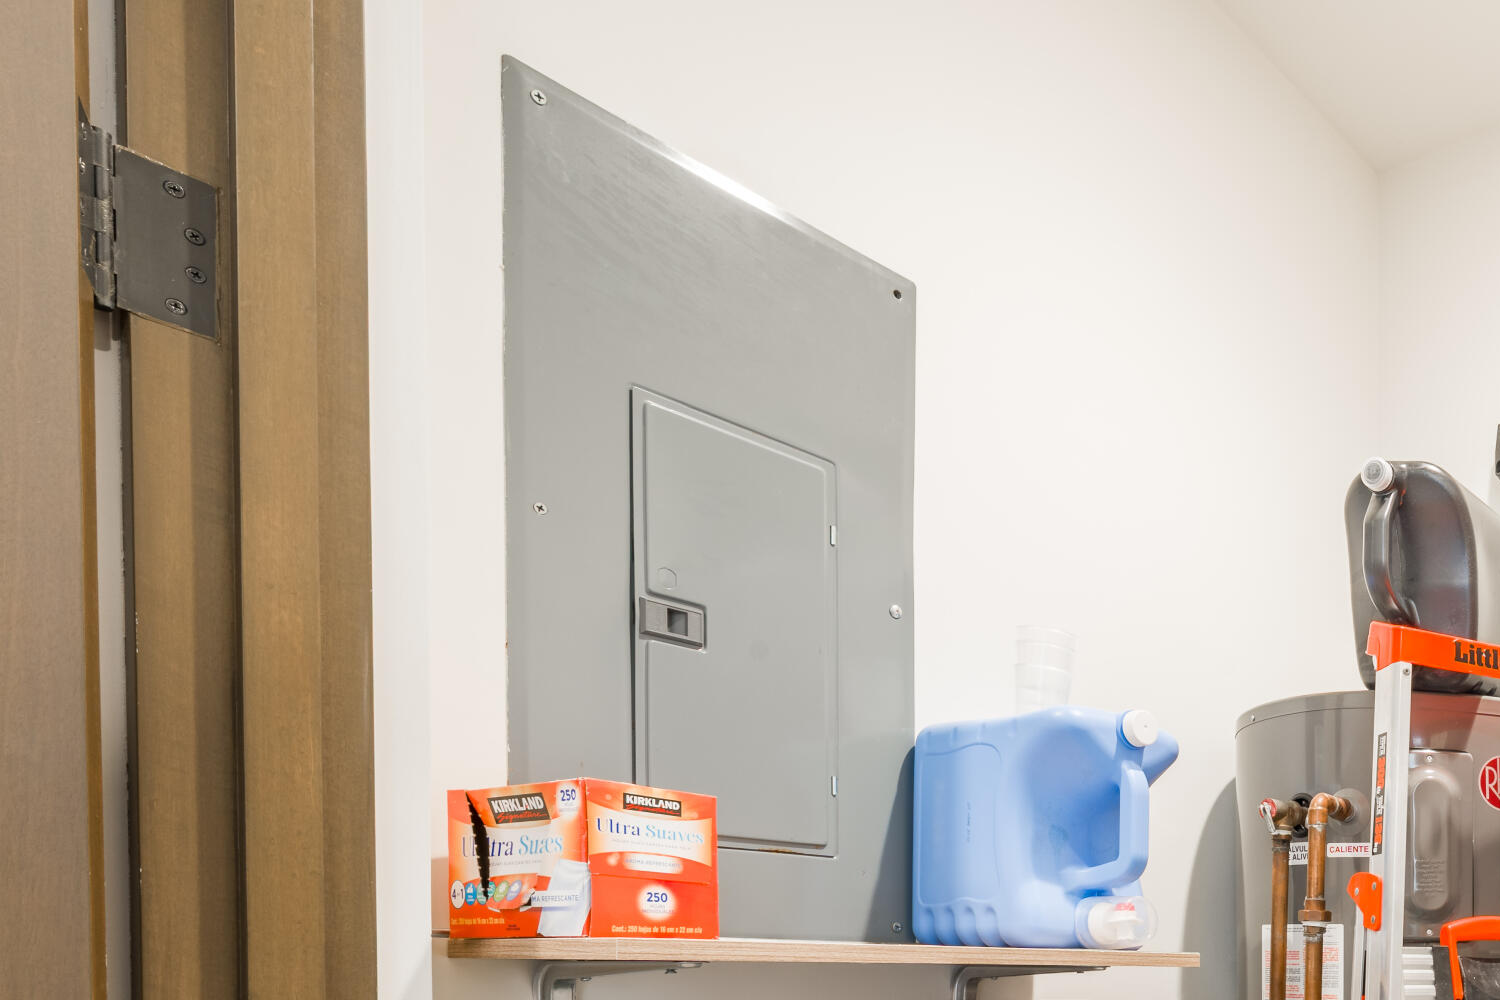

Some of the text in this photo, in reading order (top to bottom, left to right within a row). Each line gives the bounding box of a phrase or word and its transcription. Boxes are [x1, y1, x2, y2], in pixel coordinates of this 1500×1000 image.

[560, 789, 576, 802] 250
[626, 794, 680, 810] KIRKLAND
[490, 796, 544, 814] KIRKLAND
[596, 816, 640, 836] Ultra
[645, 824, 704, 844] Suaves
[646, 892, 668, 903] 250
